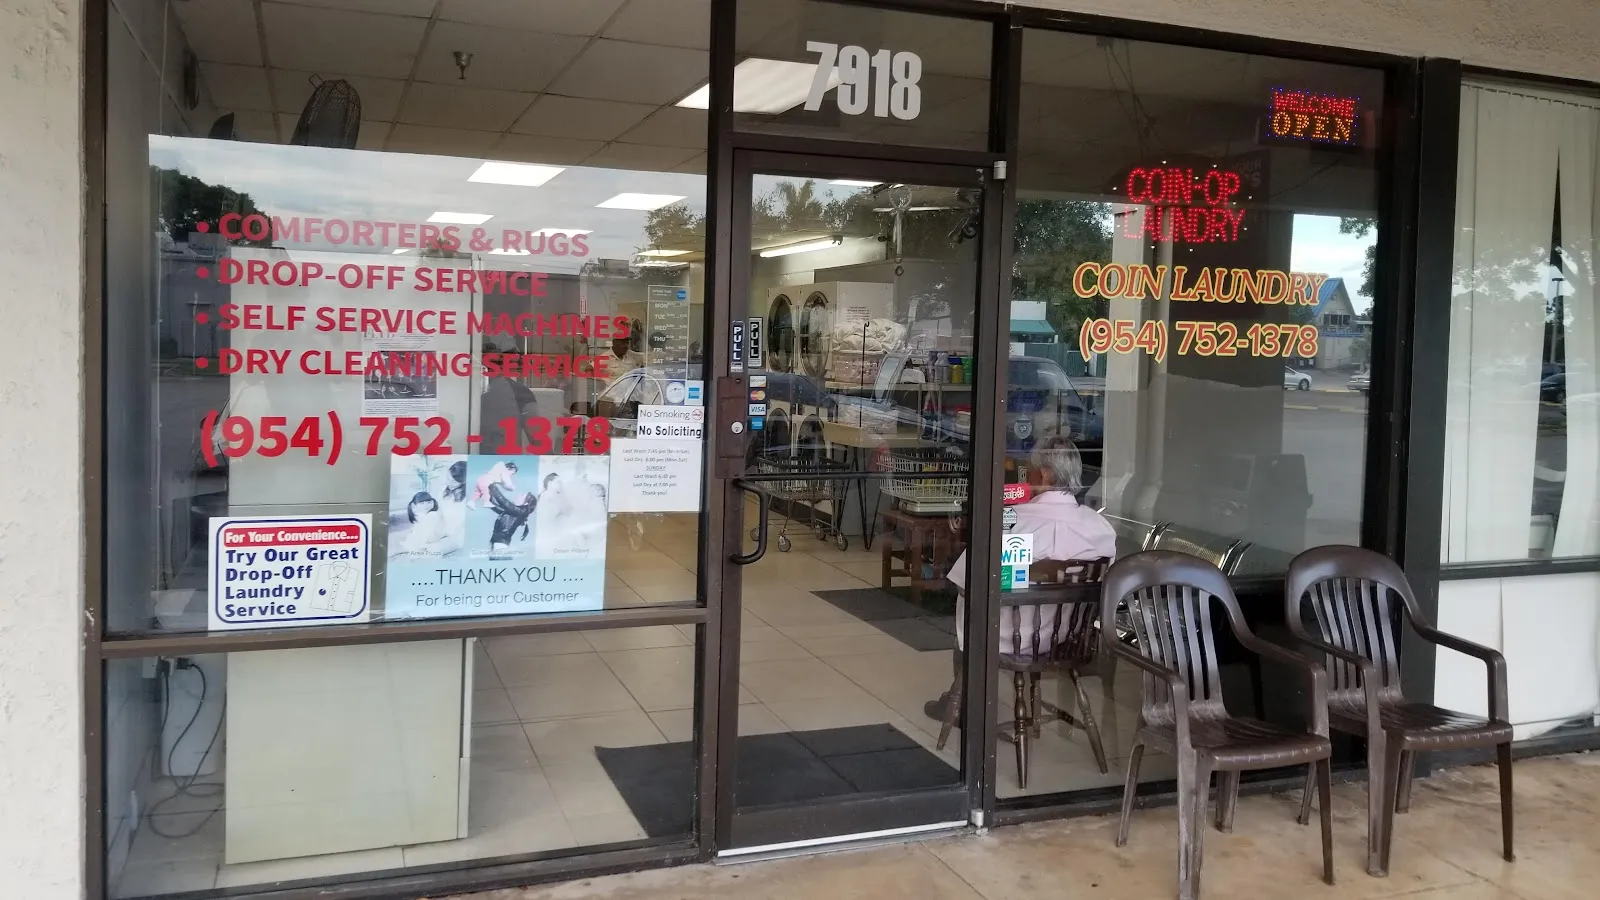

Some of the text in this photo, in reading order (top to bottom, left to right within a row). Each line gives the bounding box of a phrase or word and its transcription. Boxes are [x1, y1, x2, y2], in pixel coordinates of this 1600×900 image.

[803, 40, 922, 120] 7918
[1273, 91, 1355, 117] WELCOME
[1272, 111, 1353, 141] OPEN
[1126, 167, 1241, 206] COIN-OP
[218, 212, 590, 257] COMFORTERS & RUGS
[1122, 205, 1246, 243] LAUNDRY
[218, 258, 550, 297] DROP-OFF SERVICE
[1072, 261, 1329, 306] COIN LAUNDRY
[218, 303, 306, 330] SELF
[315, 306, 457, 335] SERVICE
[467, 311, 631, 339] MACHINES
[733, 326, 741, 360] PULL
[750, 323, 758, 357] PULL
[1079, 317, 1318, 364] (954) 752-1378
[218, 348, 610, 378] DRY CLEANING SERVICE
[640, 409, 690, 420] No Smoking
[200, 409, 611, 468] (954) 752 - 1378
[638, 426, 702, 438] No Soliciting
[226, 529, 359, 544] For Your Convenience...
[226, 547, 359, 566] Try Our Great
[1001, 548, 1032, 564] WiFi
[225, 565, 314, 583] Drop-Off
[513, 566, 557, 583] YOU
[225, 584, 304, 600] Laundry
[416, 591, 579, 608] For being our Customer
[225, 602, 297, 618] Service
